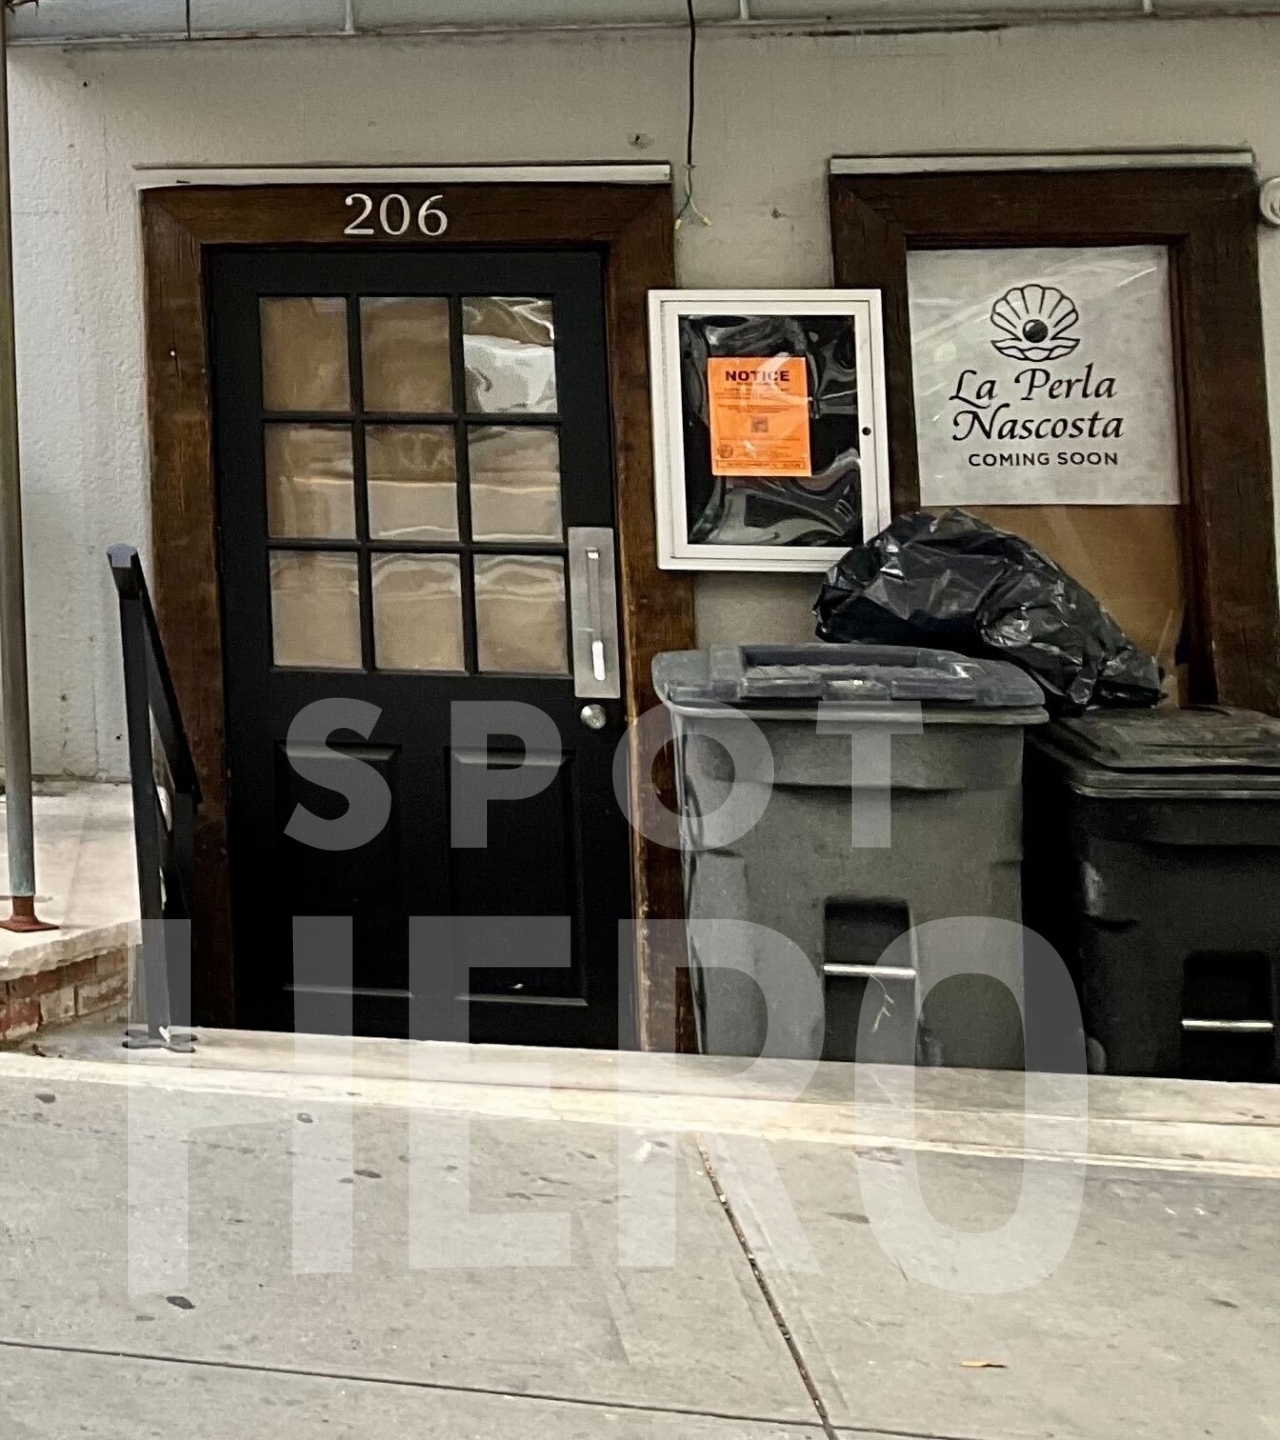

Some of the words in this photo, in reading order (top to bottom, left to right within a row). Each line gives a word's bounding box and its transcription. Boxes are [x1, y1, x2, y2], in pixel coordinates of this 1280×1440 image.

[343, 193, 449, 236] 206
[725, 370, 790, 382] NOTICE
[948, 369, 999, 409] La
[1014, 362, 1118, 401] Perla
[952, 403, 1124, 441] Nascosta
[968, 453, 1050, 467] COMING
[1057, 451, 1119, 466] SOON
